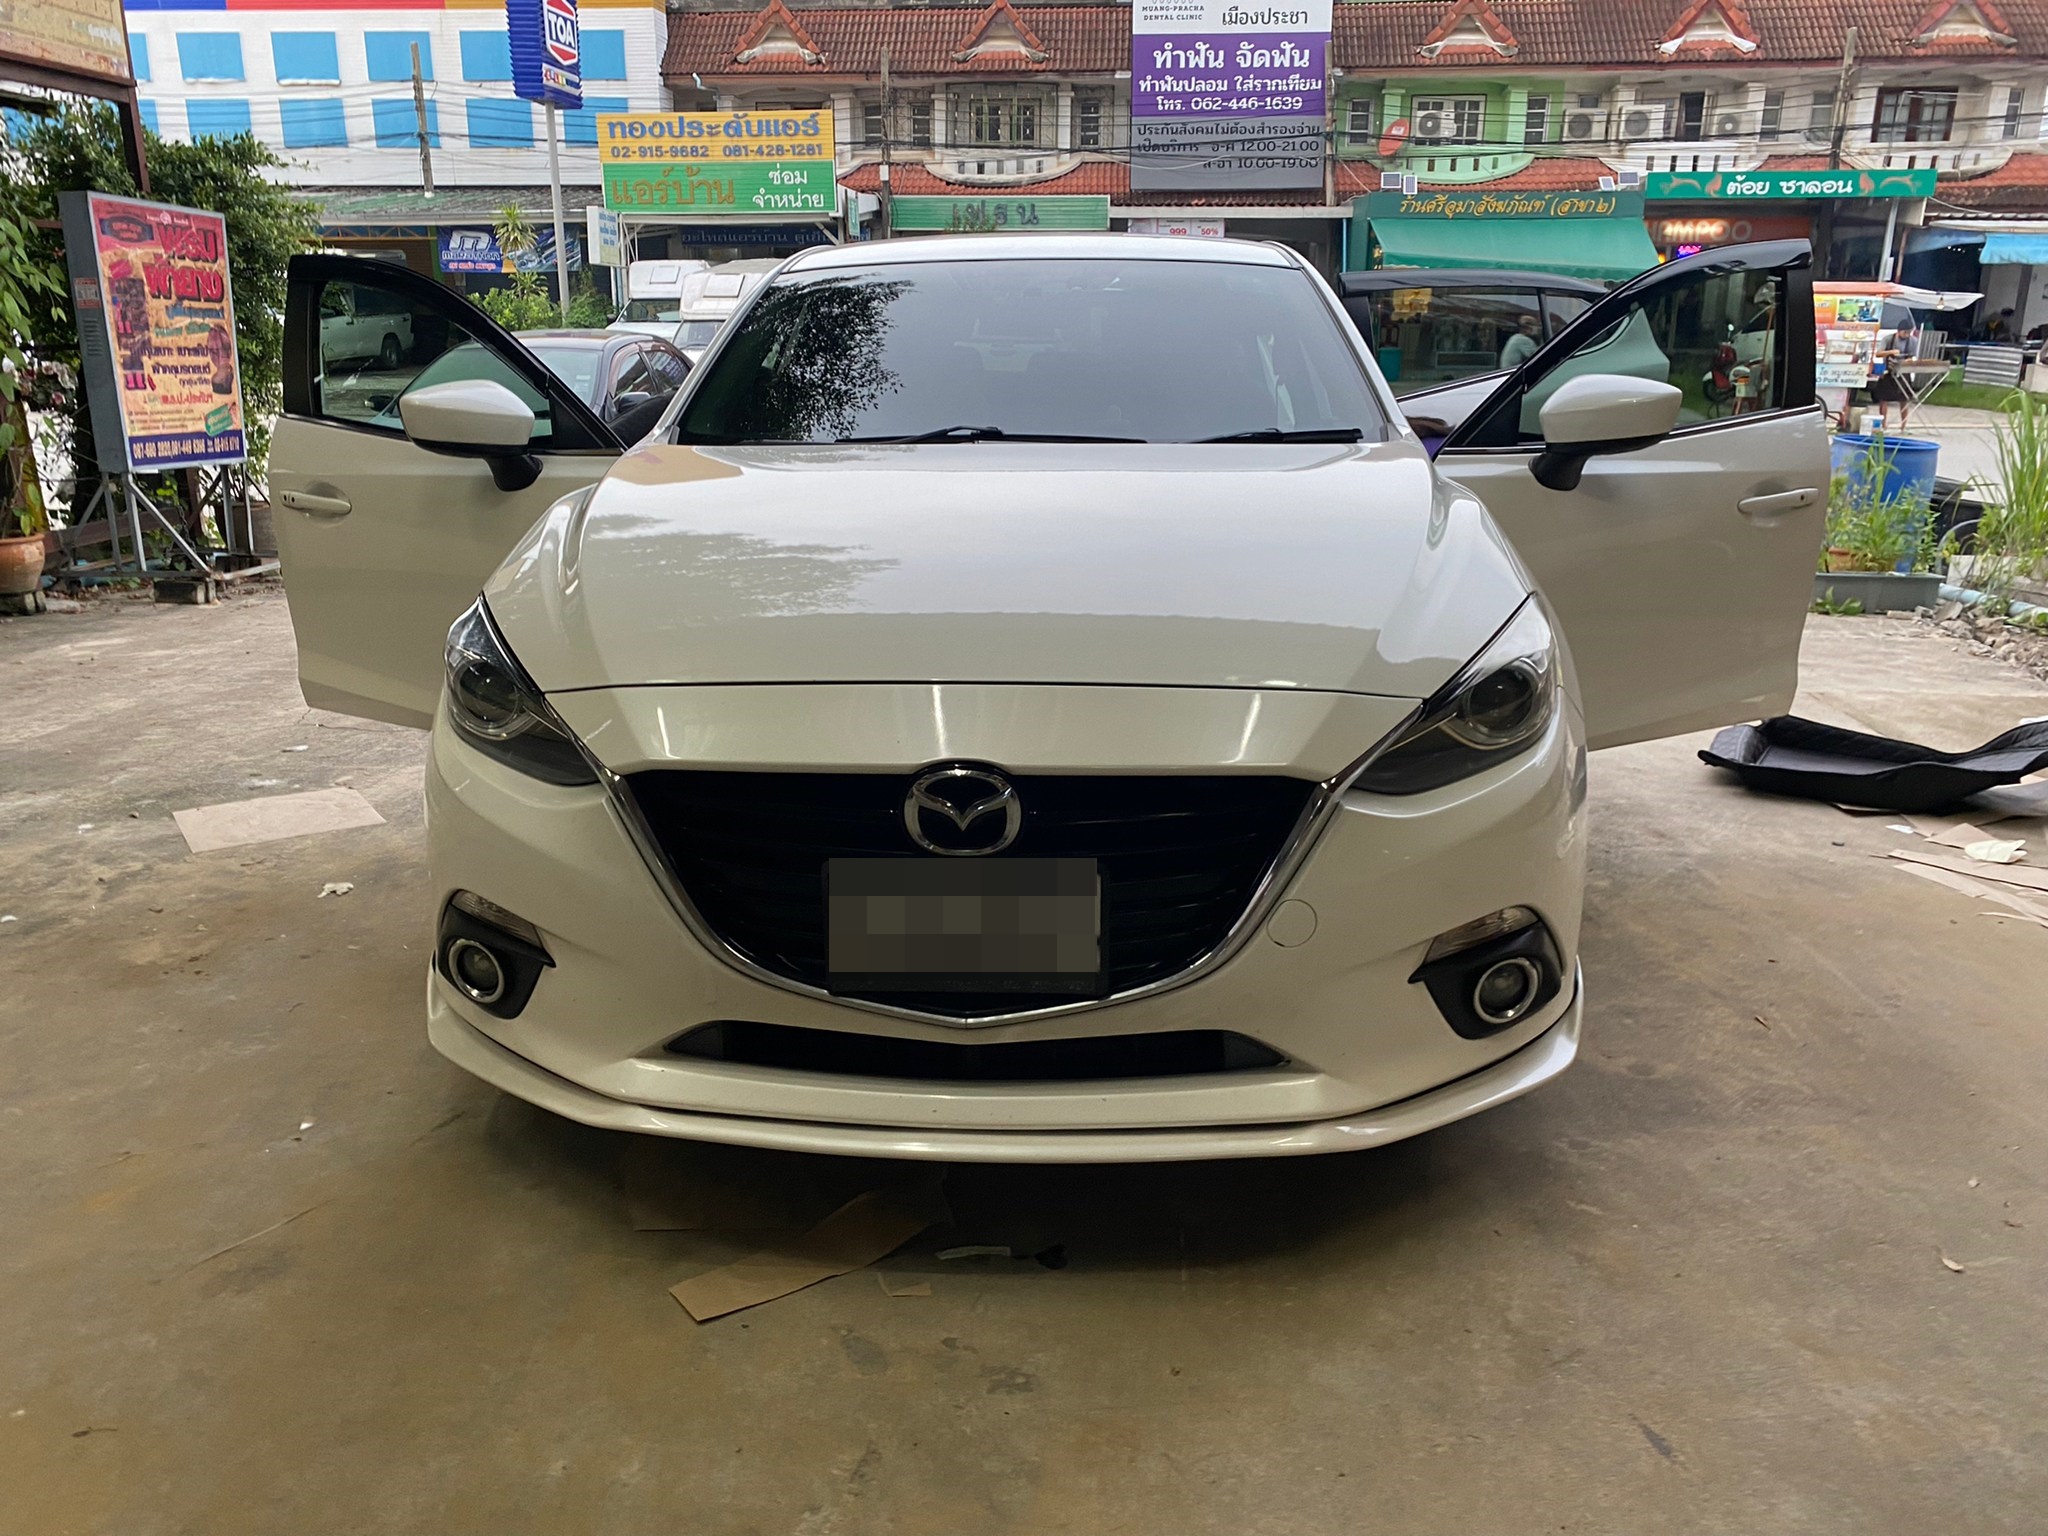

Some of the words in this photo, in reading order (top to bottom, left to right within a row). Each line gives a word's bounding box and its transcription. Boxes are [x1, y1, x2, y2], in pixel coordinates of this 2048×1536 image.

[1222, 6, 1308, 26] เมืองประชา
[548, 12, 575, 48] TOA
[1153, 41, 1225, 69] ทำฟัน
[1236, 41, 1310, 68] จัดฟัน
[1139, 74, 1228, 92] ทำฟันปลอม
[1234, 73, 1322, 91] ใส่รากเทียม
[1156, 96, 1186, 110] โทร.
[1191, 96, 1303, 110] 062-446-1639
[608, 112, 820, 139] ทองประดับแอร์
[1137, 122, 1320, 136] ประกันสังคมไม่ต้องสำรองจ่าย
[611, 145, 709, 158] 02-915-9682
[723, 143, 823, 157] 081-428-1281
[1137, 138, 1199, 152] เปิดบริการ
[768, 163, 808, 185] ซ่อม
[611, 166, 735, 205] แอร์บ้าน
[1726, 175, 1769, 196] ต้อย
[1779, 175, 1853, 195] ซาลอน
[752, 189, 824, 208] จำหน่าย
